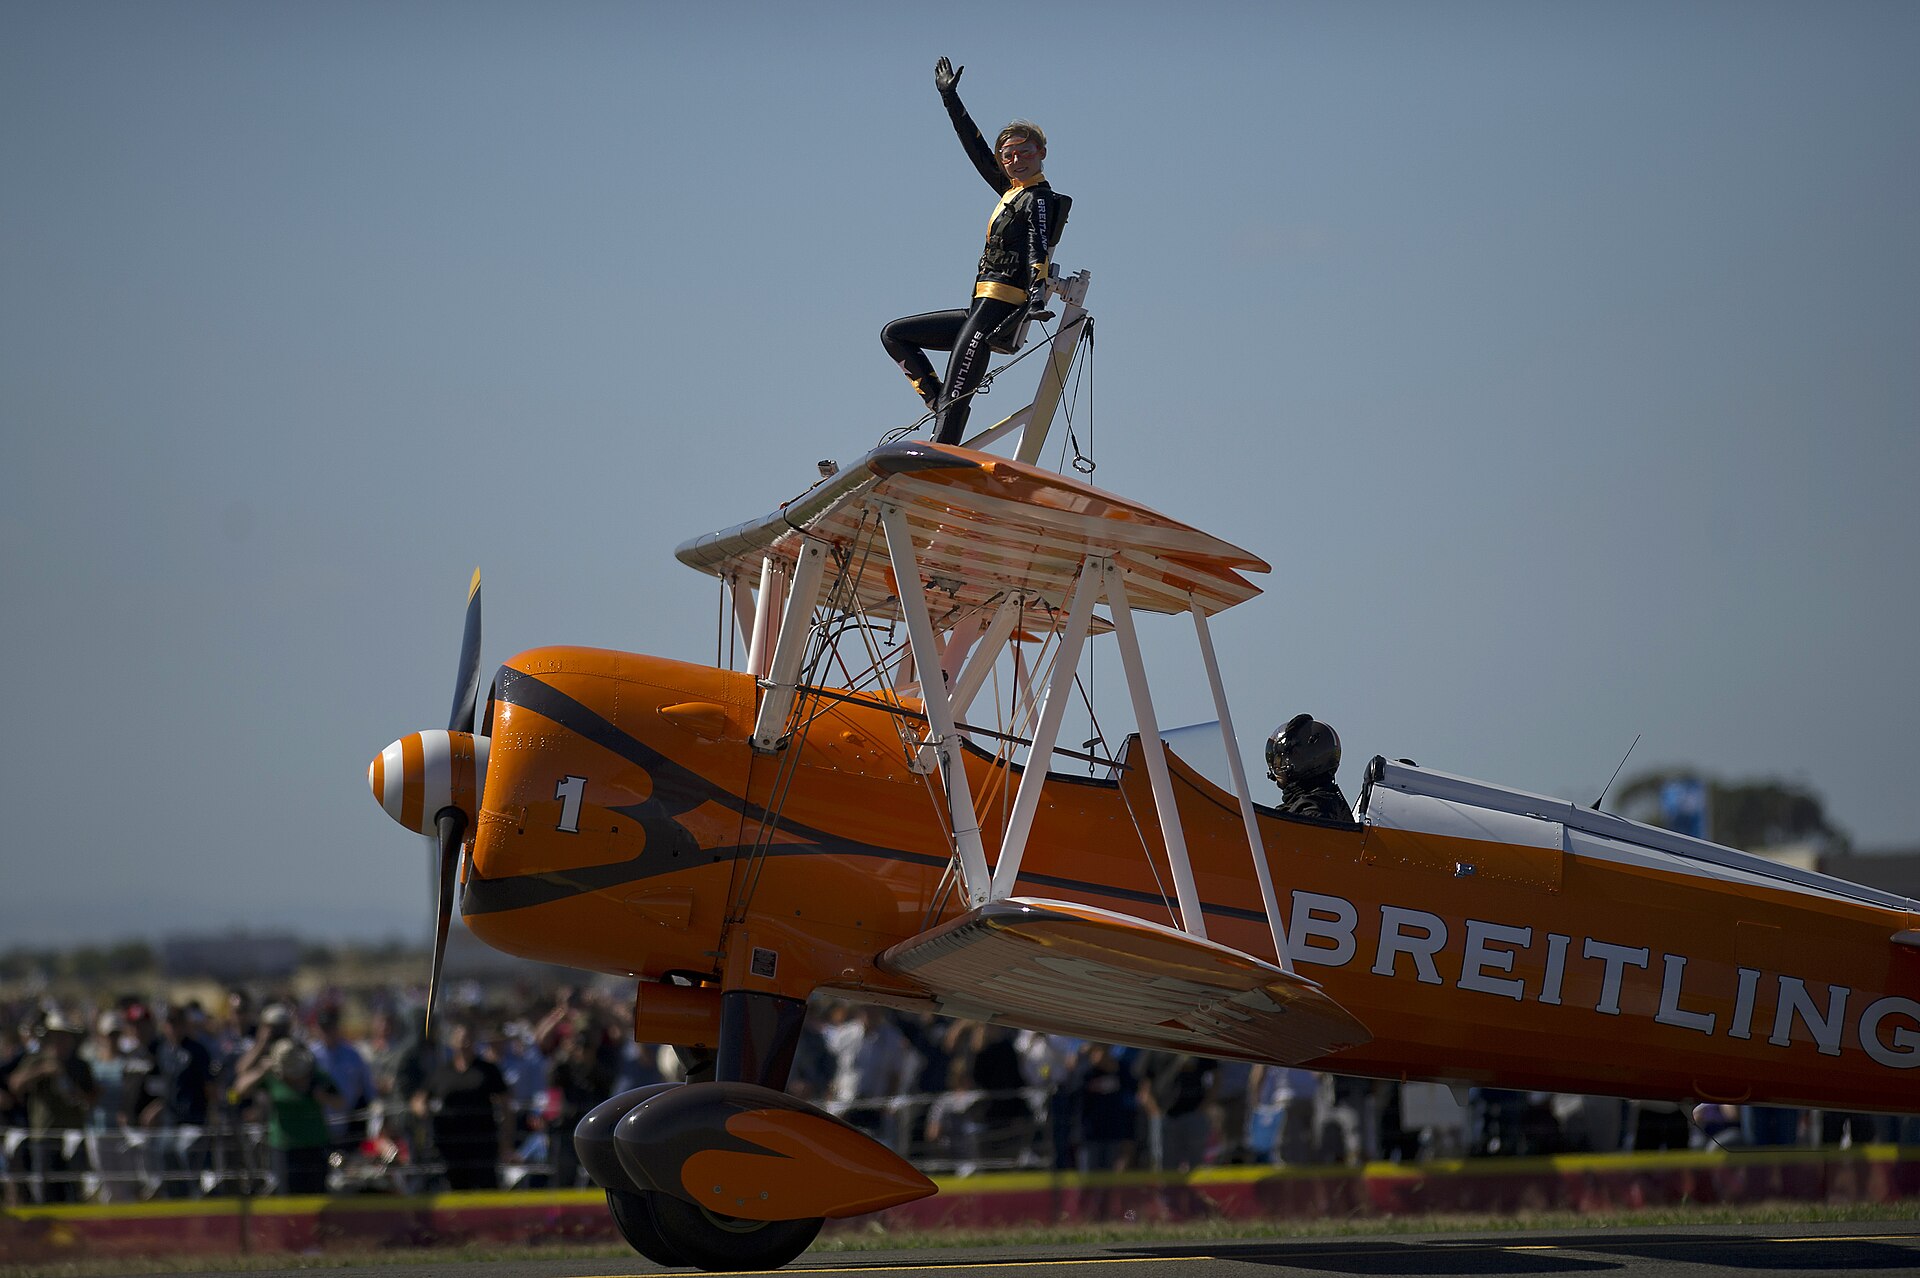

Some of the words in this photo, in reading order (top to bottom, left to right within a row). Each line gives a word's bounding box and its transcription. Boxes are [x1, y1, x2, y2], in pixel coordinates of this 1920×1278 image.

[951, 330, 984, 398] BREITLING
[555, 775, 588, 833] 1
[1288, 889, 1920, 1069] BREITLING
